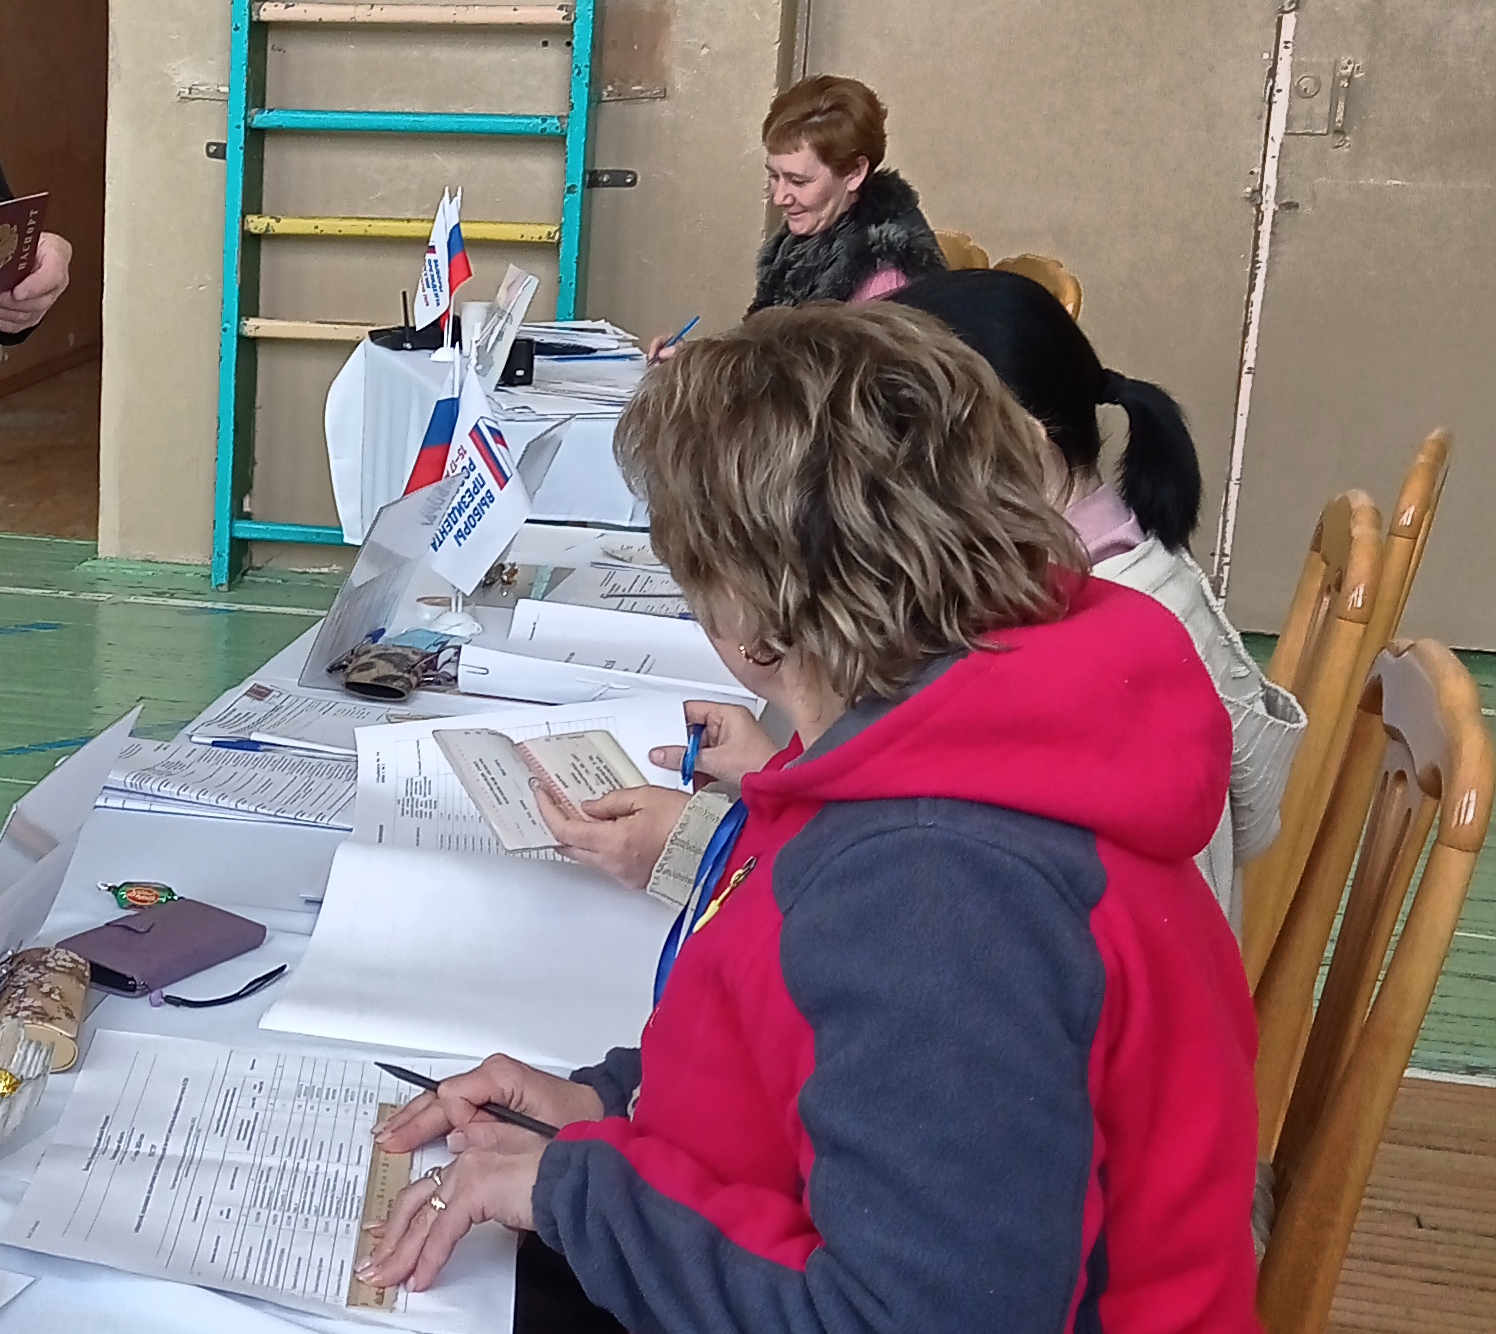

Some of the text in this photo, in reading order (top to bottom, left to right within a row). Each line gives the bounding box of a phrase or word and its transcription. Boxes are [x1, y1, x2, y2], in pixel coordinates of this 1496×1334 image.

[18, 209, 39, 271] ПАСПОРТ
[433, 259, 443, 292] ВЫБОРЫ
[430, 472, 486, 552] ПРЕЗИДЕНТА
[453, 488, 495, 547] ВЫБОРЫ
